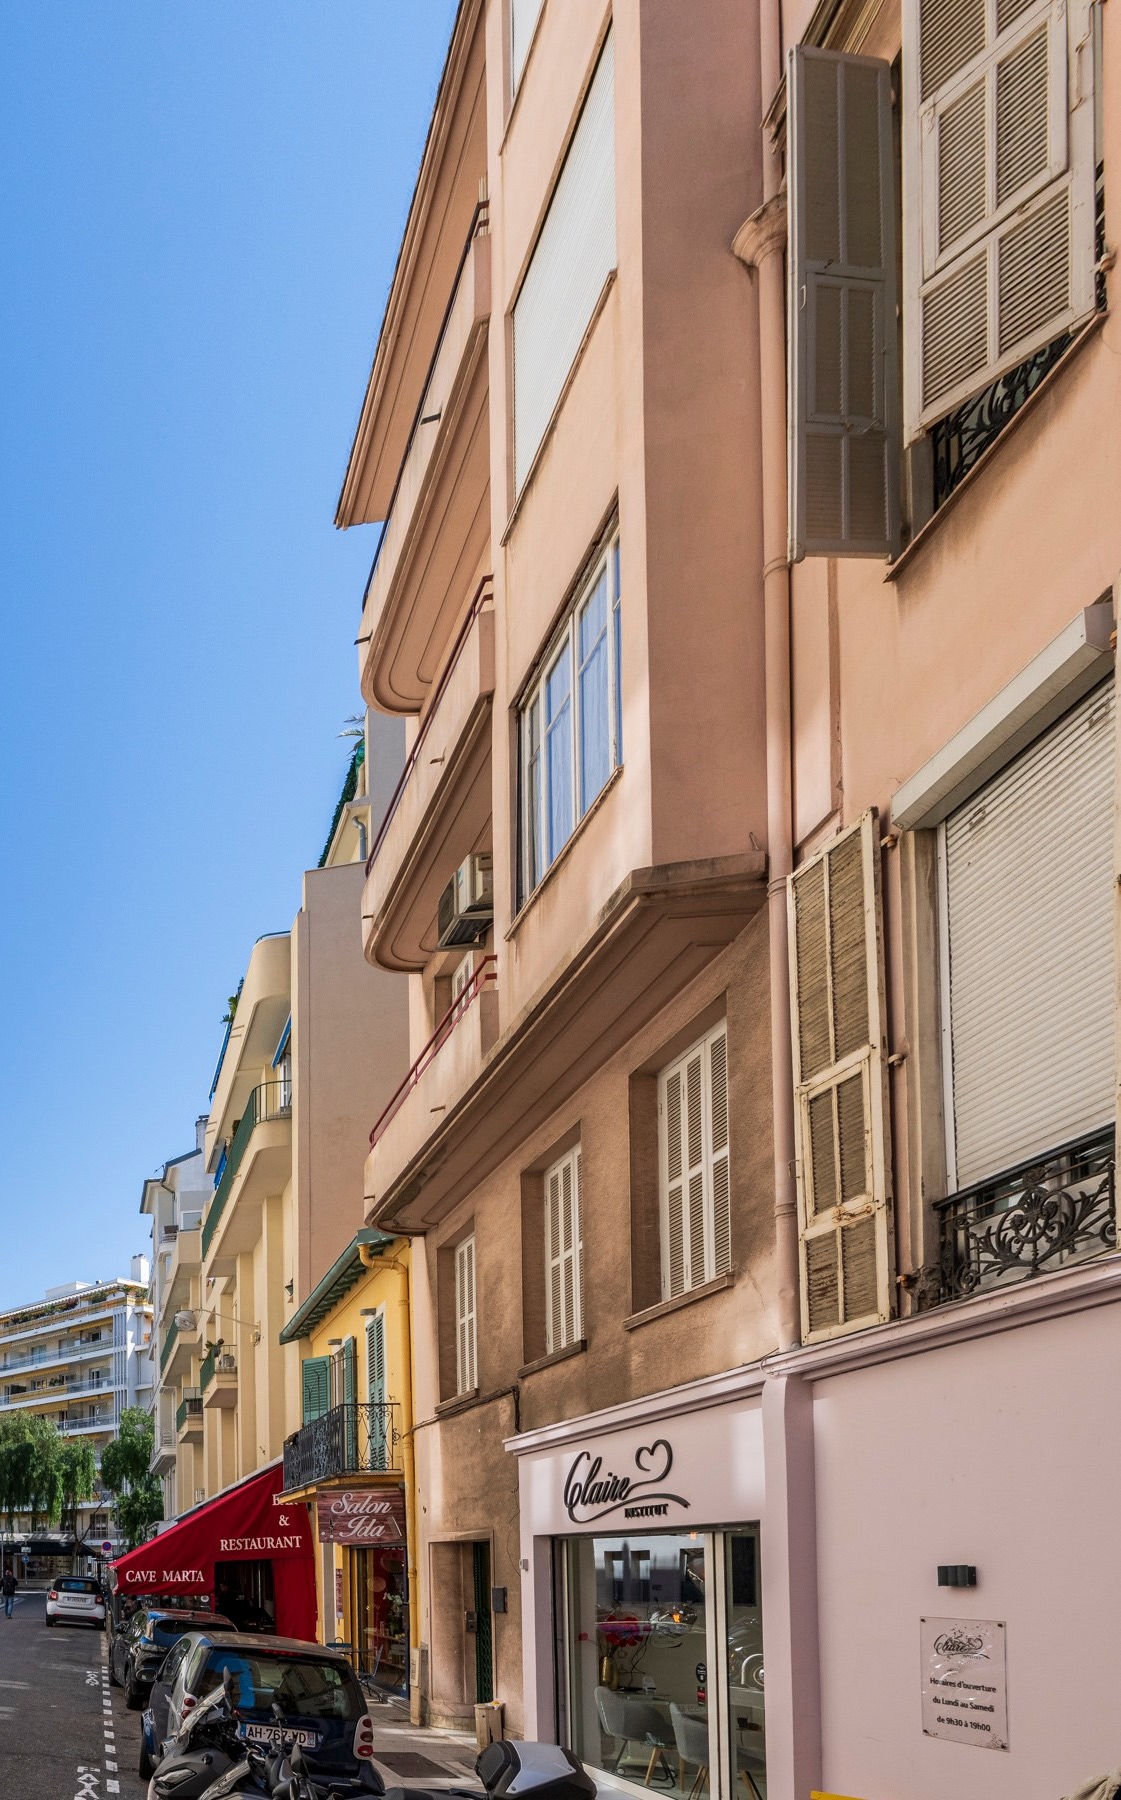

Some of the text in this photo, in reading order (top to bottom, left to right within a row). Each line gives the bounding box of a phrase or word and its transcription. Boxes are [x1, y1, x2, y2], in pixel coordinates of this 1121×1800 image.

[330, 1492, 392, 1515] Salon
[624, 1503, 669, 1519] INSTITUT
[278, 1514, 290, 1527] &
[339, 1515, 386, 1538] Ida
[220, 1536, 302, 1551] RESTAURANT
[125, 1570, 205, 1583] CAVE MARTA
[930, 1677, 997, 1693] Hoaires d'ouverture
[932, 1696, 941, 1704] du
[942, 1697, 959, 1706] Lundi
[970, 1702, 995, 1712] Samedi
[946, 1717, 962, 1727] 9h30
[969, 1722, 991, 1732] 19h00
